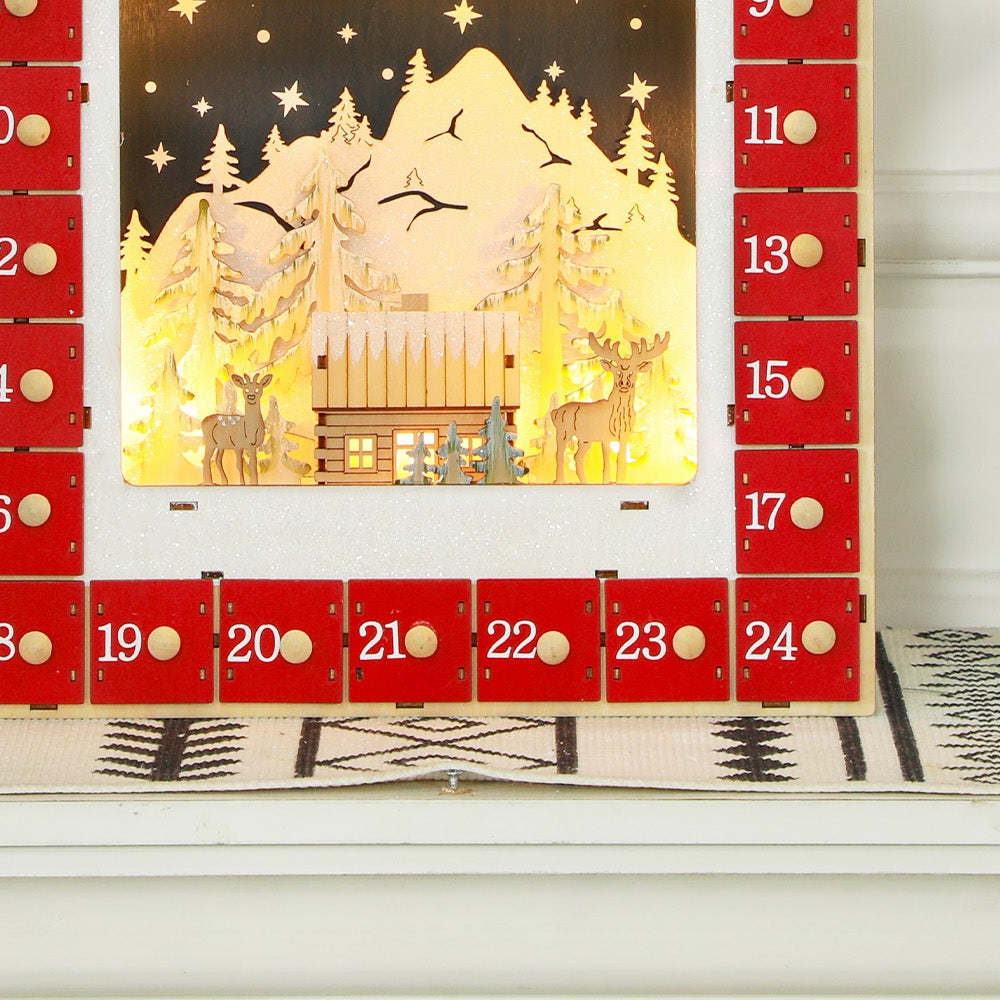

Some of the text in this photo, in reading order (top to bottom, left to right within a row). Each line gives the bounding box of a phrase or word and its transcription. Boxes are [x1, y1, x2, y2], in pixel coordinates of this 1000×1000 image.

[744, 105, 784, 145] 11
[743, 235, 789, 274] 13
[746, 359, 790, 399] 15
[745, 491, 786, 531] 17
[97, 623, 142, 662] 19
[227, 623, 280, 663] 20
[359, 620, 407, 661] 21
[487, 619, 541, 659] 22
[615, 621, 667, 661] 23
[745, 620, 798, 661] 24
